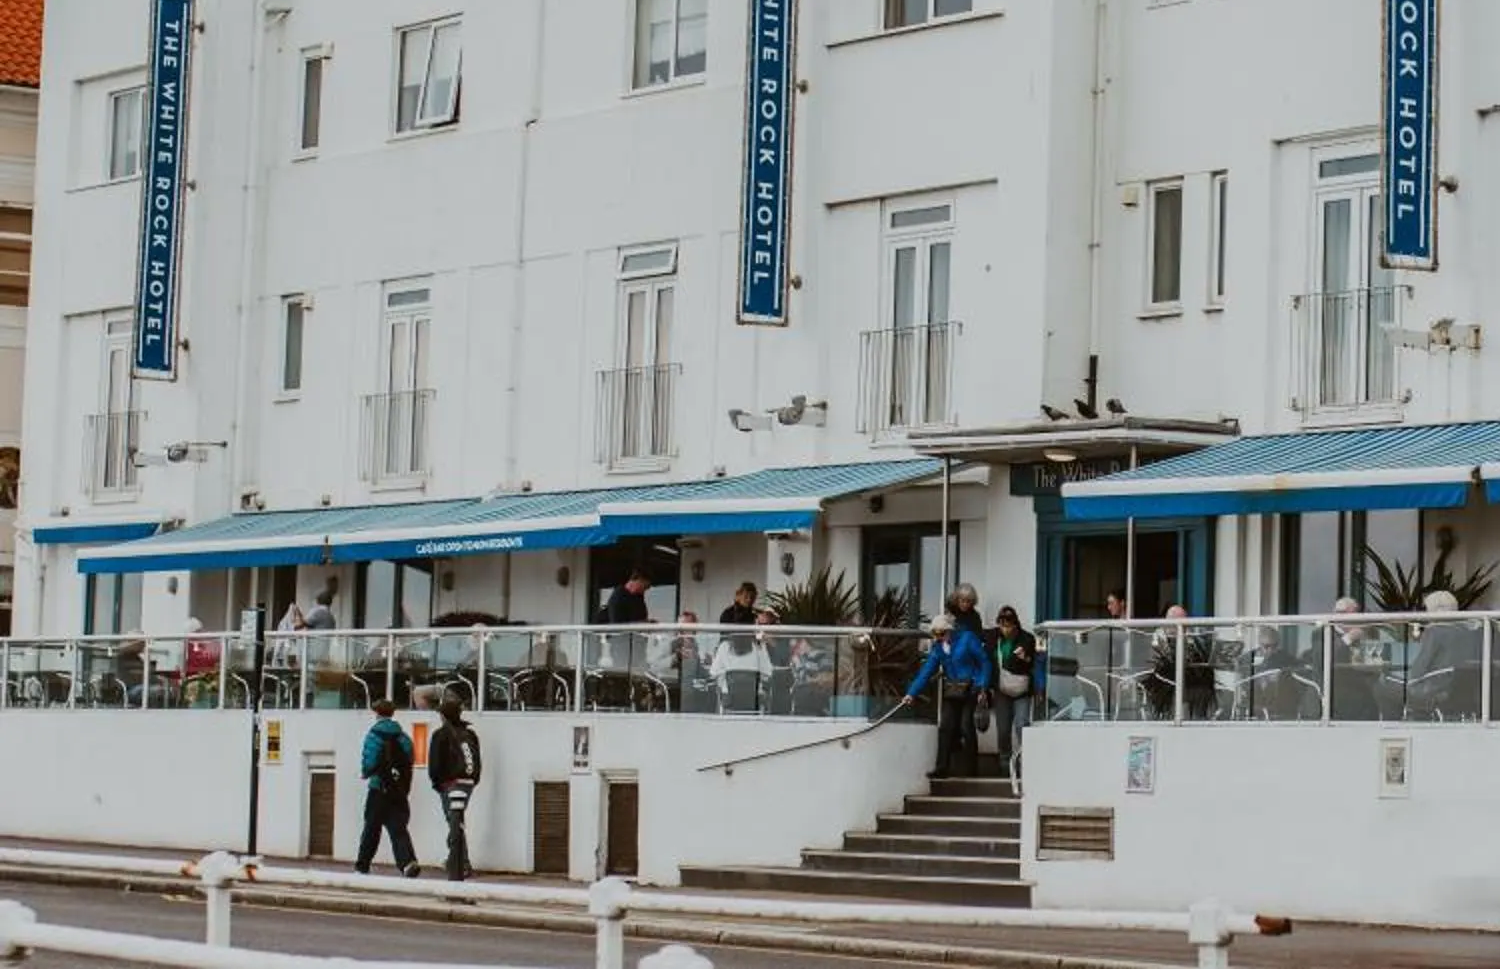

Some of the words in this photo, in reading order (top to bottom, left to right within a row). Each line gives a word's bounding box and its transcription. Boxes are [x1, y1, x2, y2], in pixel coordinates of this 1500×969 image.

[164, 20, 179, 67] THE
[158, 82, 176, 163] WHITE
[760, 78, 777, 164] ROCK
[1398, 98, 1417, 218] HOTEL
[153, 177, 171, 247] ROCK
[754, 182, 773, 283] HOTEL
[147, 261, 165, 344] HOTEL
[1033, 465, 1057, 488] The
